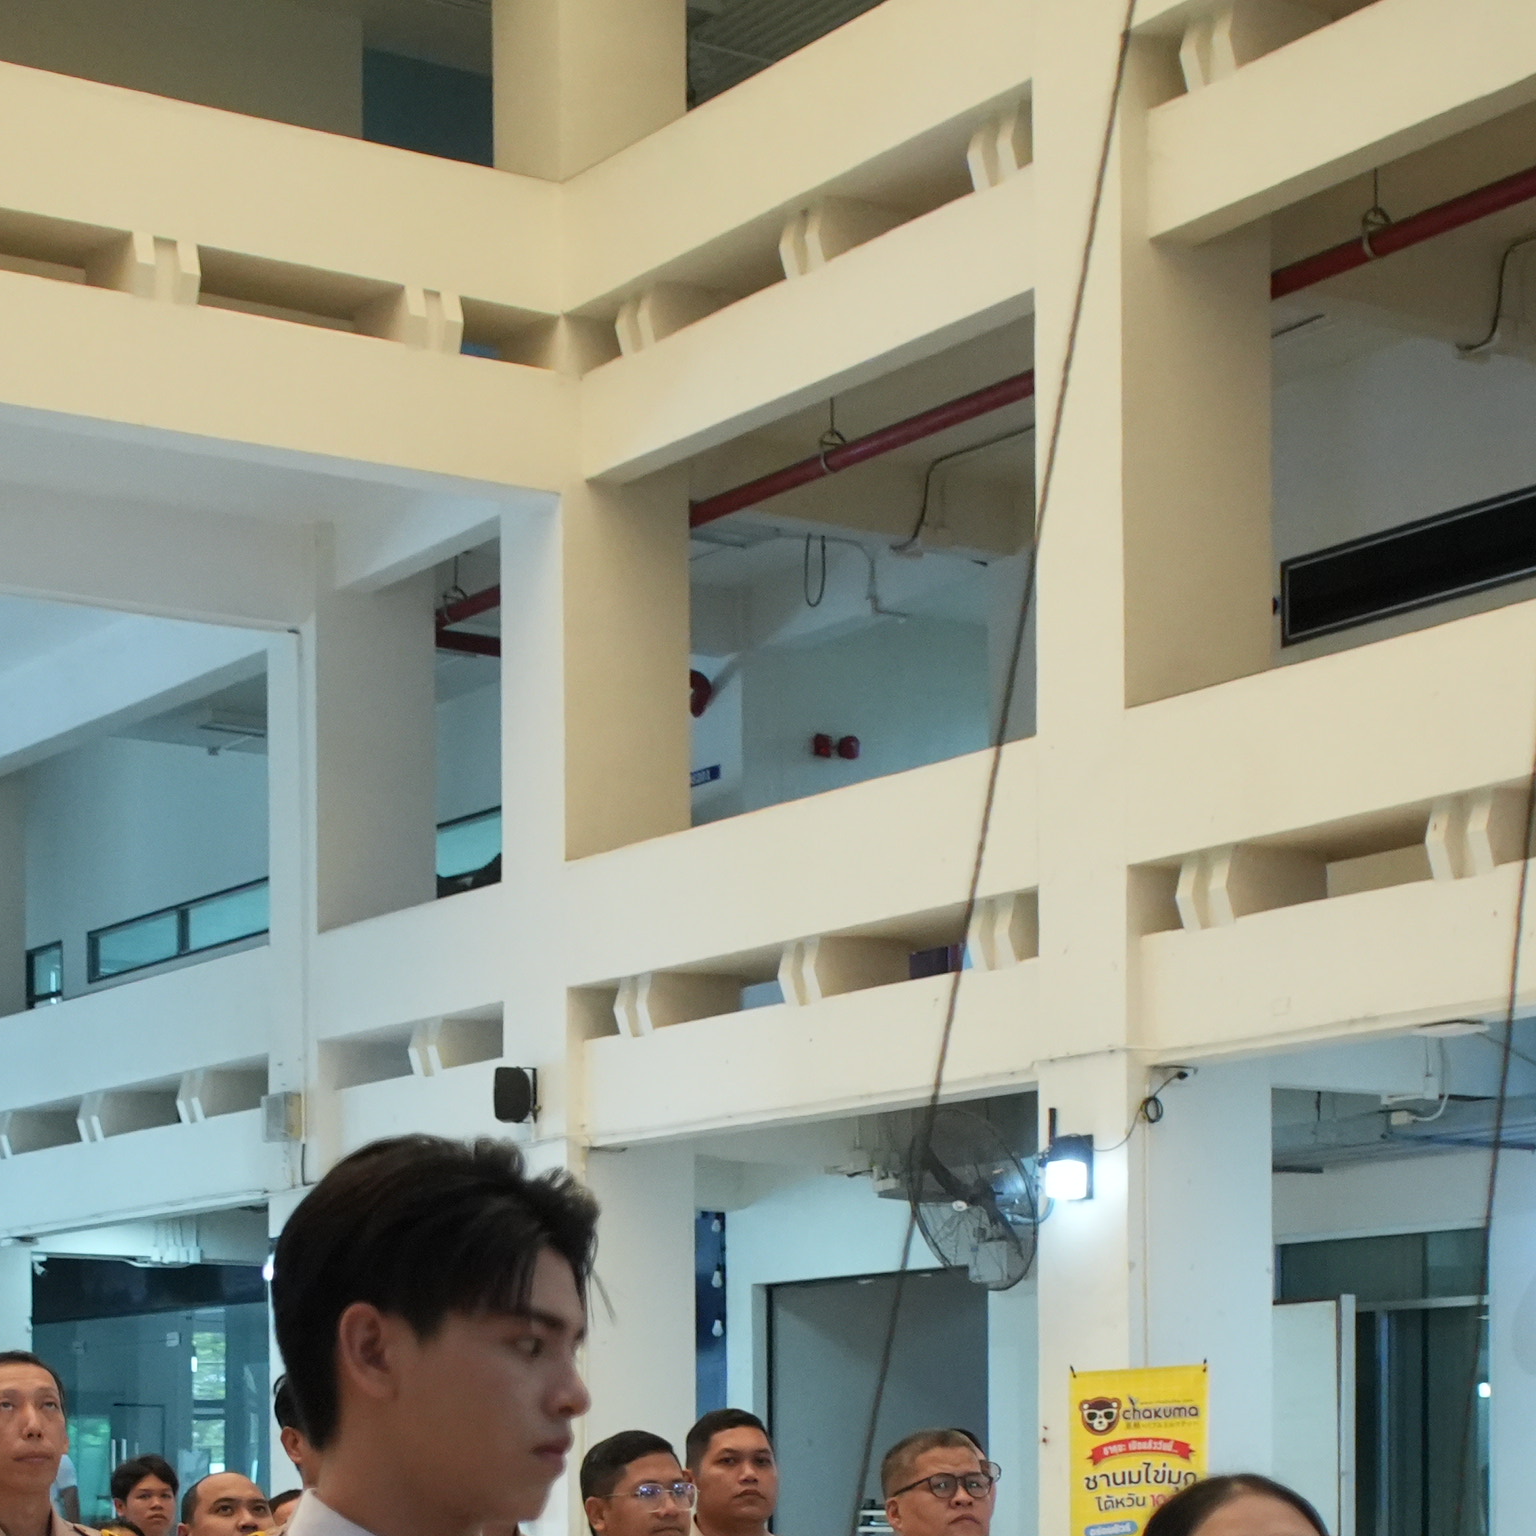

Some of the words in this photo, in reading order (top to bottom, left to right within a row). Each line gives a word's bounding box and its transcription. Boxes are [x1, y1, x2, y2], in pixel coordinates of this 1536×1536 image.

[1122, 1397, 1199, 1420] chakuma
[1084, 1462, 1197, 1493] ชานมไข่มุก
